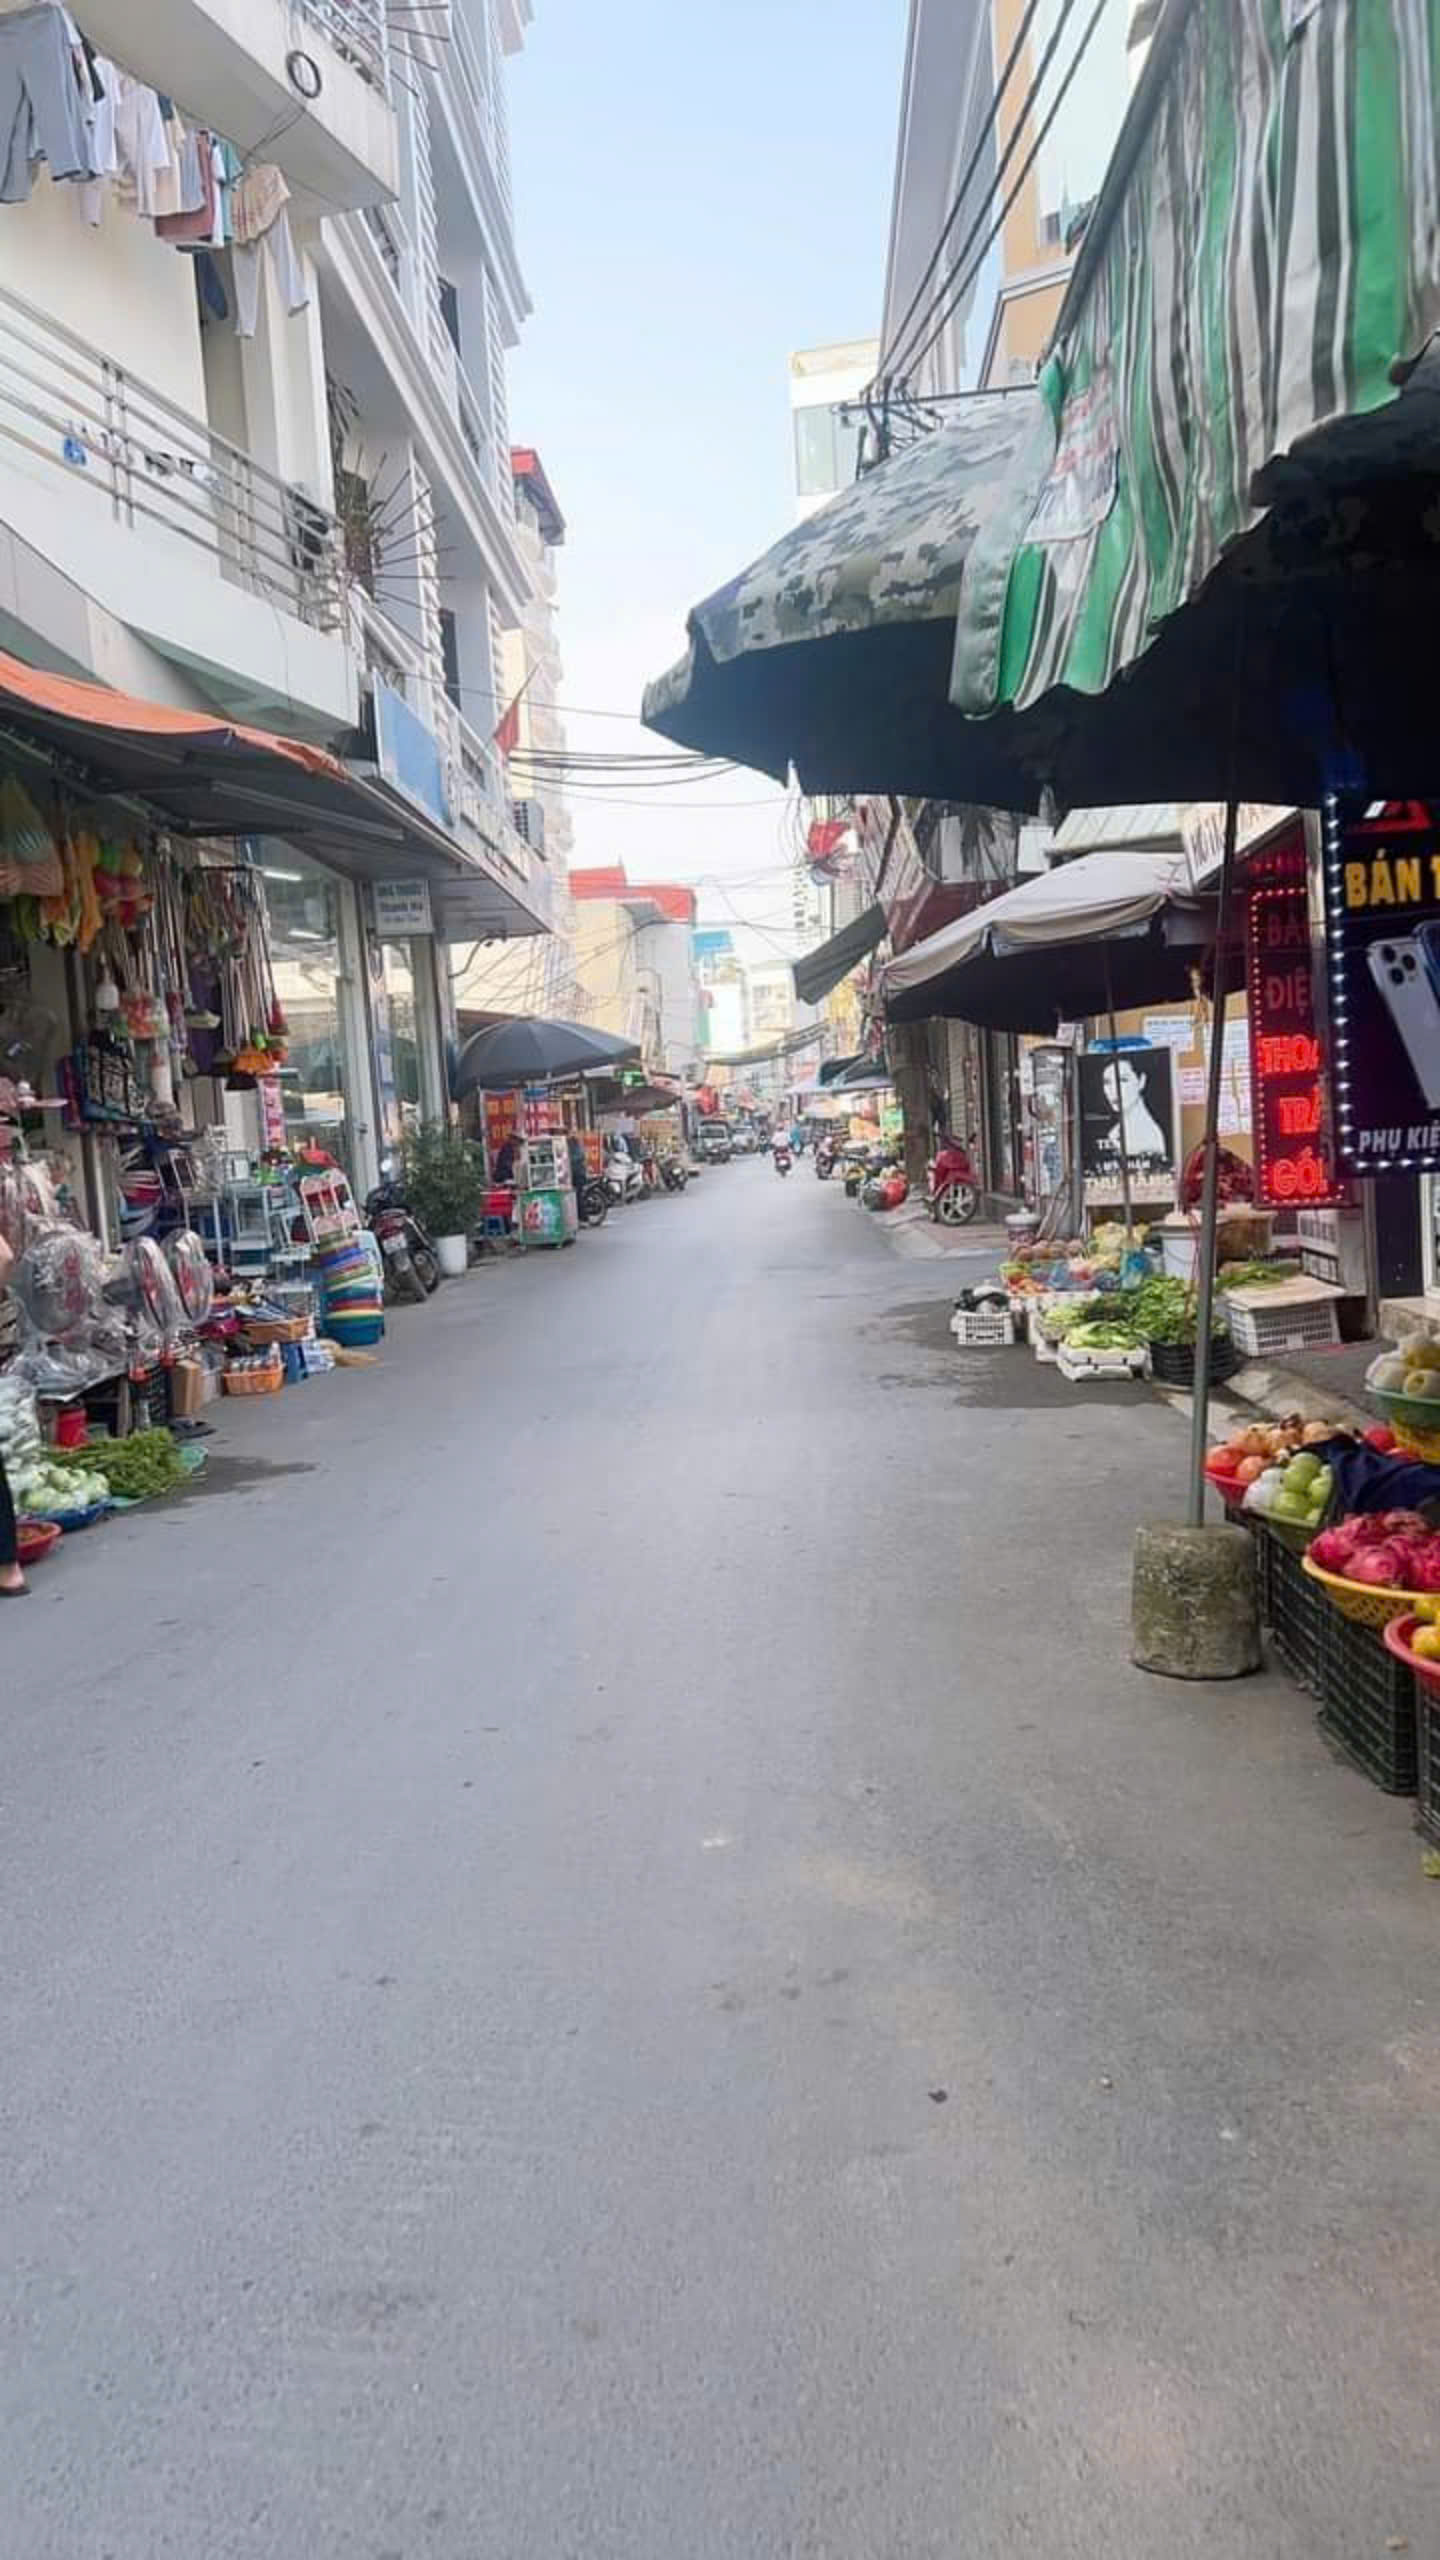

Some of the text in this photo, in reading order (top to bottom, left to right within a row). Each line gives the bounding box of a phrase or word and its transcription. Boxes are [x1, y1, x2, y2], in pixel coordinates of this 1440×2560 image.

[1345, 848, 1421, 907] BÁN
[1265, 966, 1308, 1017] ĐIỆ
[1359, 1119, 1440, 1158] PHỤ KIỆ
